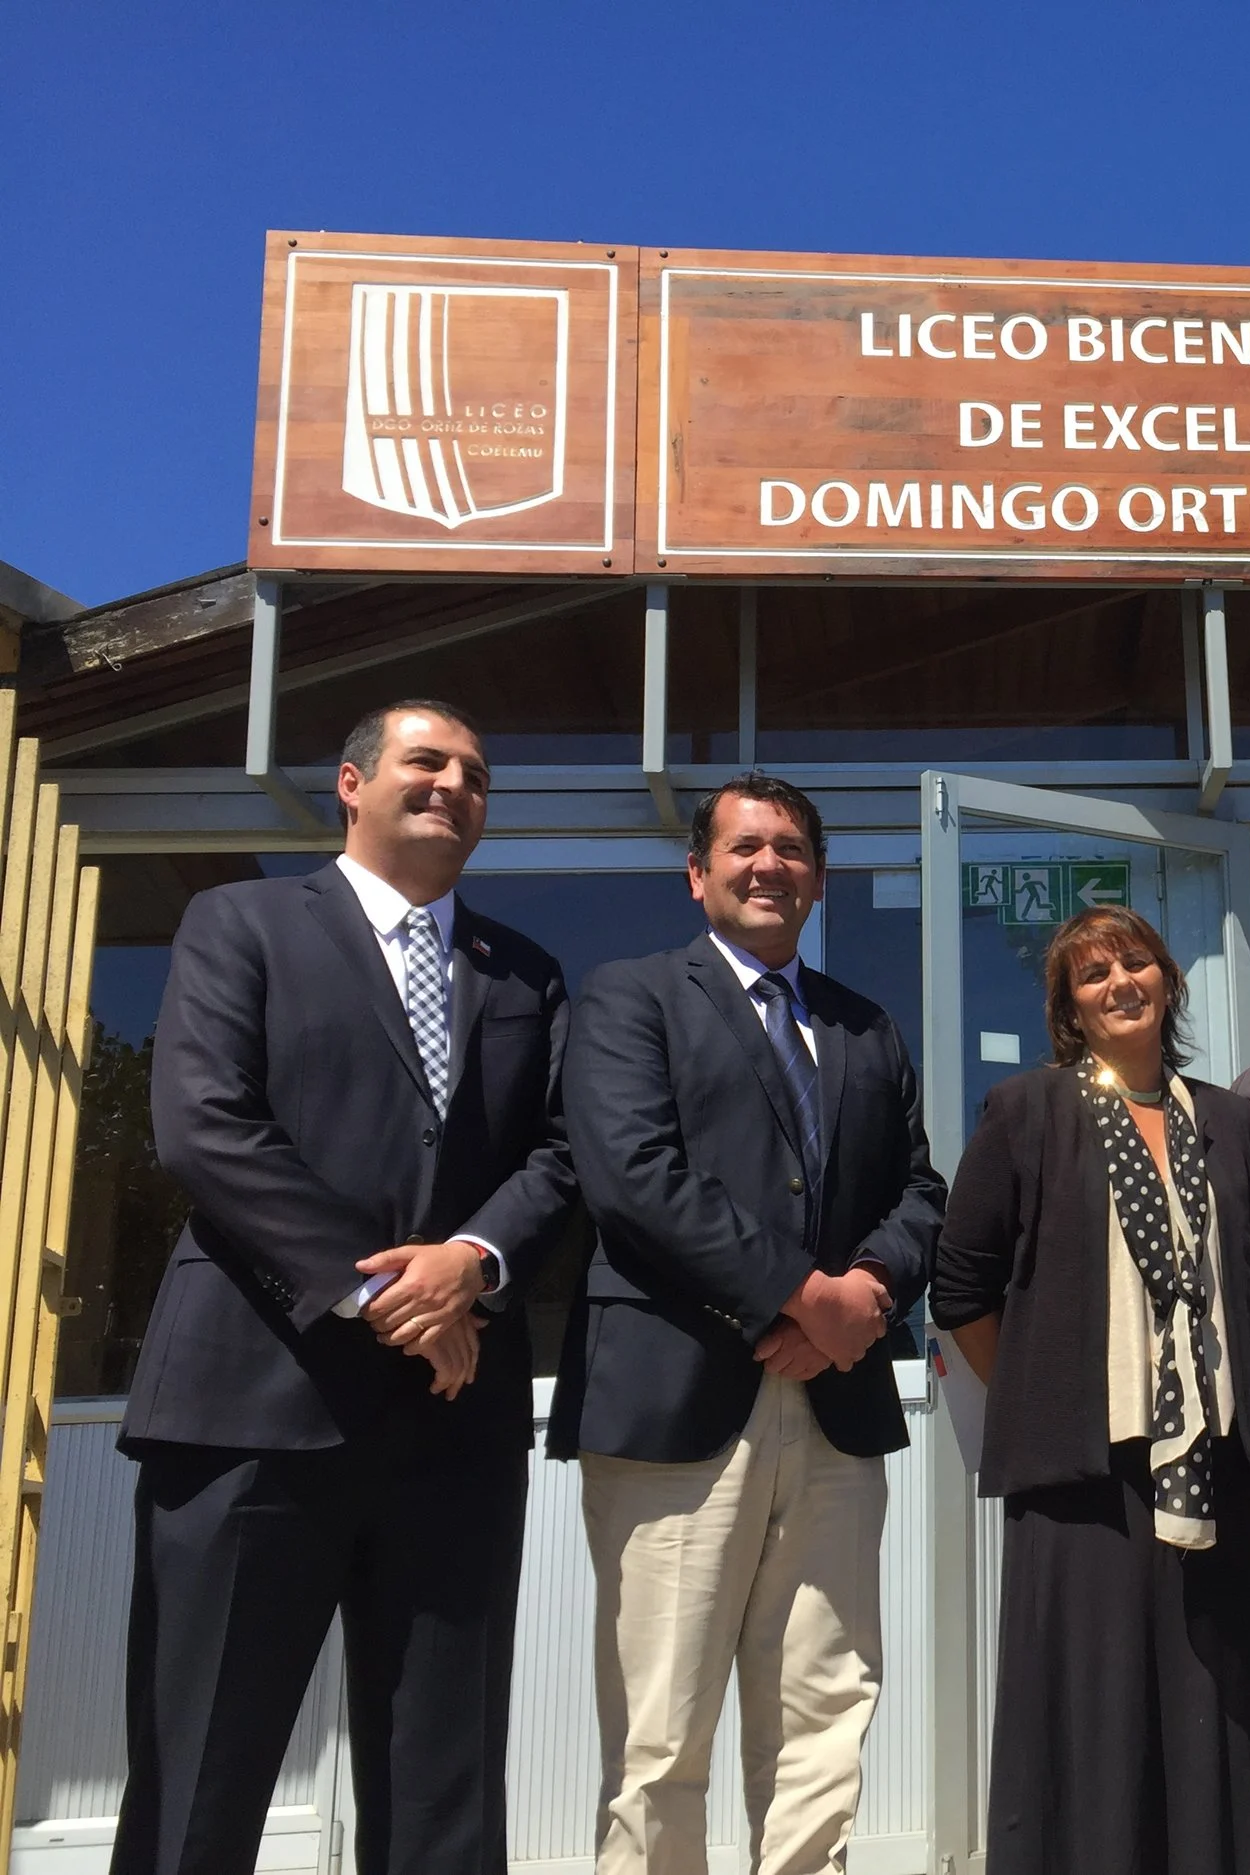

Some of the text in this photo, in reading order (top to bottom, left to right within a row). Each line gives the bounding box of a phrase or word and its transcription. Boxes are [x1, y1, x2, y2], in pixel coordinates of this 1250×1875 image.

[859, 312, 1048, 361] LICEO
[464, 402, 548, 419] LICEO
[958, 402, 1044, 449] DE
[467, 422, 488, 434] DE
[466, 443, 544, 458] COELEMU
[759, 480, 1099, 532] DOMINGO
